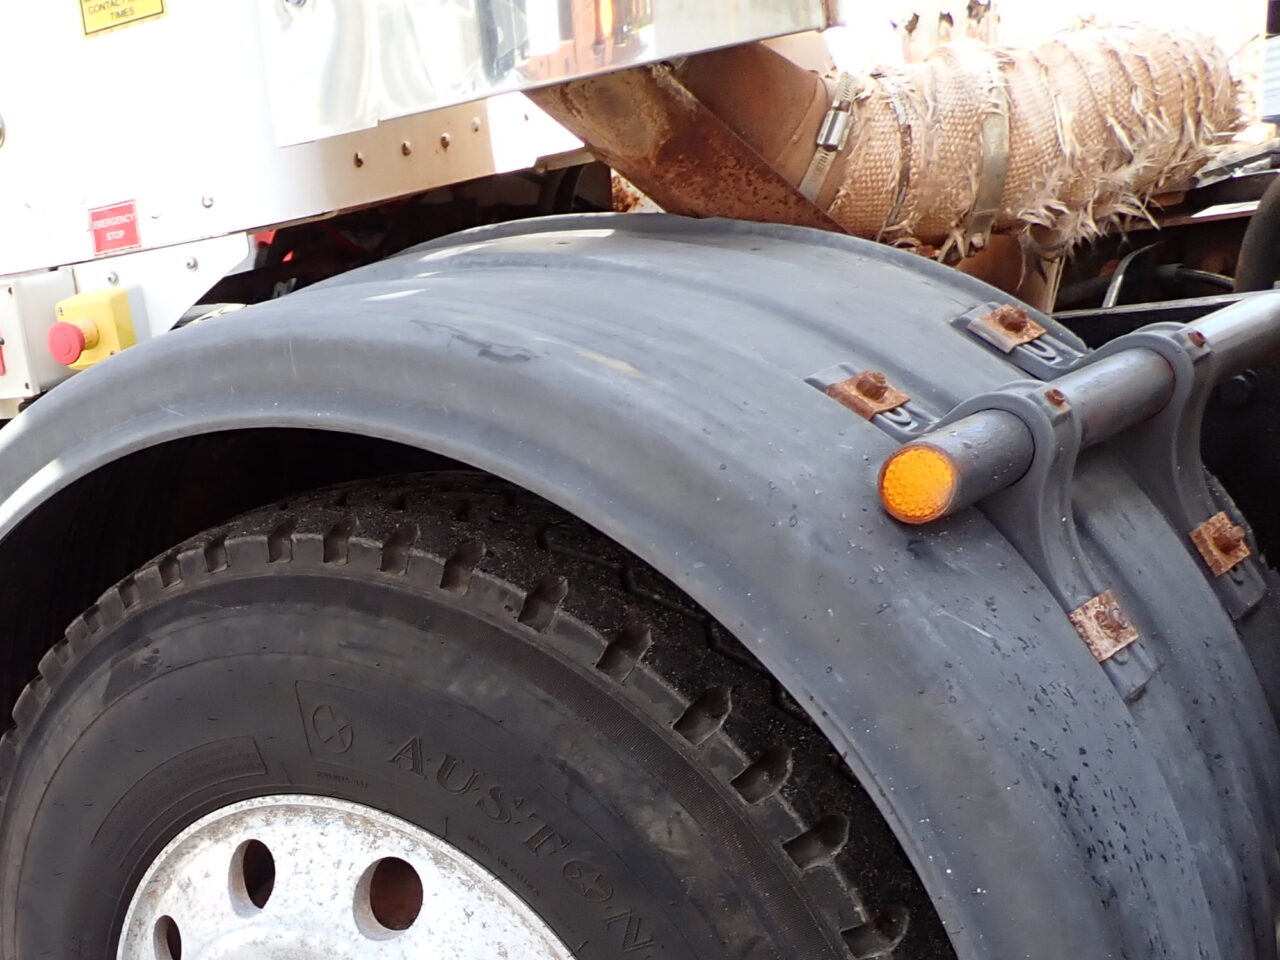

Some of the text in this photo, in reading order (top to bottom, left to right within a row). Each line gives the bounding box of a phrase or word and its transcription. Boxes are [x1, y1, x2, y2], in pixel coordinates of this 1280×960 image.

[110, 7, 135, 20] TIMES
[92, 213, 135, 230] EMERGENCY
[106, 229, 125, 241] STOP
